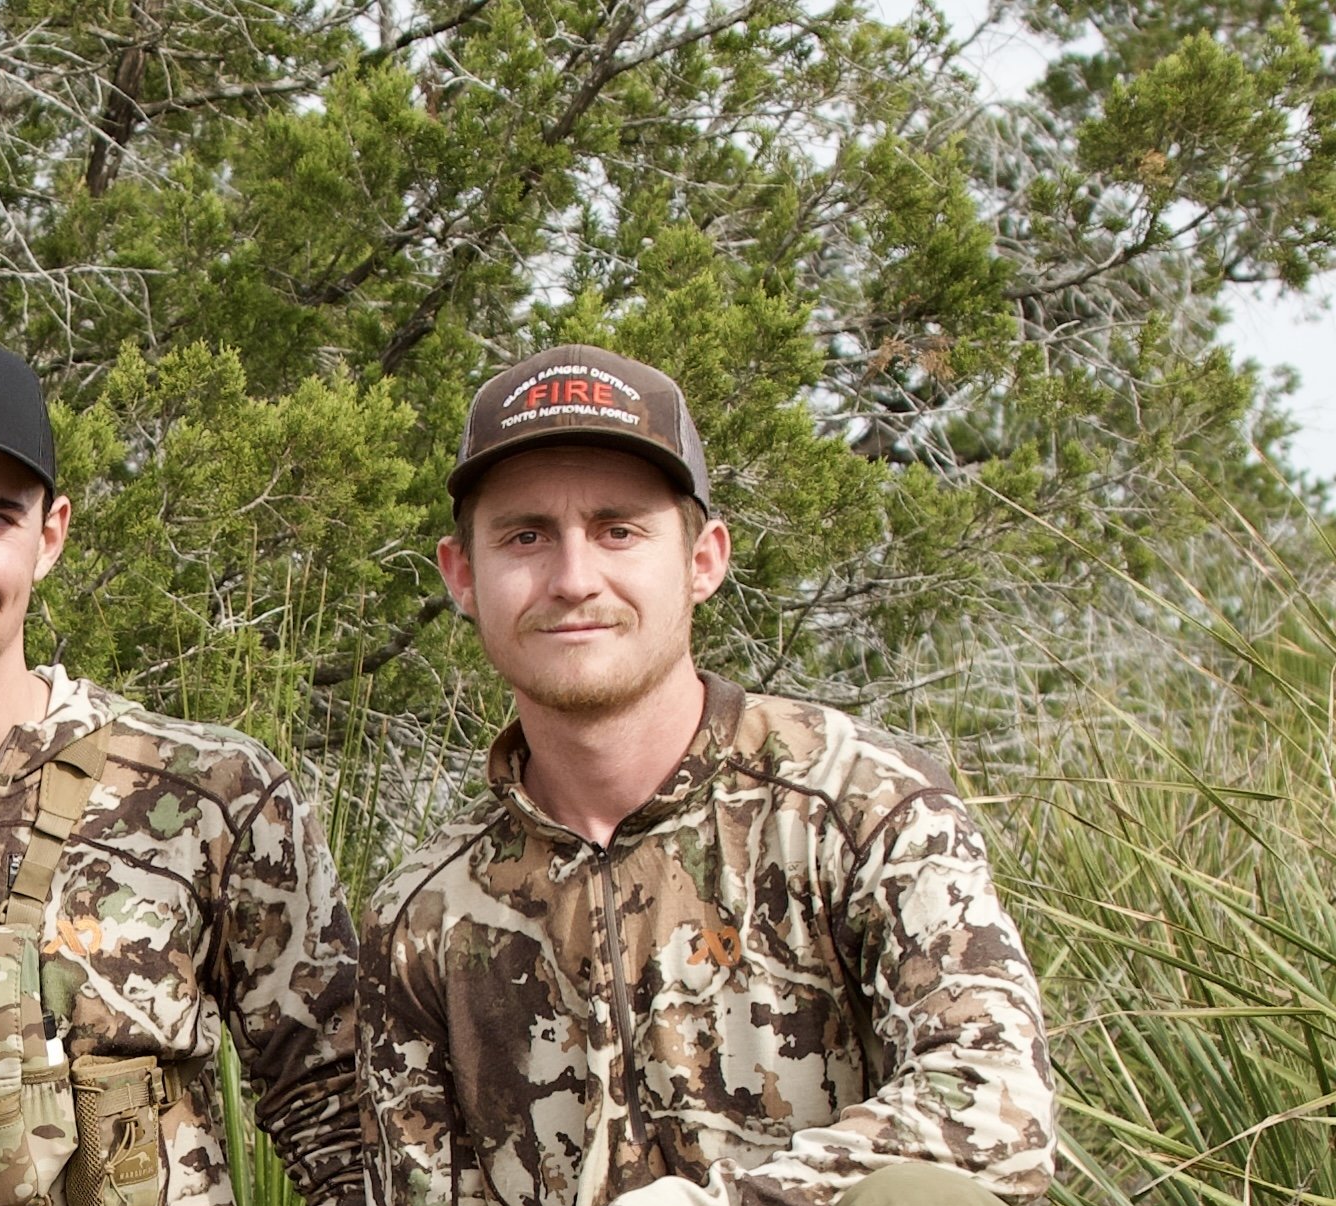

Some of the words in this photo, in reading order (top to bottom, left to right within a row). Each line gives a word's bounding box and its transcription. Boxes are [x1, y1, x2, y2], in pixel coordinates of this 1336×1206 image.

[502, 377, 537, 408] GLOBE
[538, 365, 588, 382] RANGER
[590, 367, 641, 401] DISTRICT
[526, 379, 614, 408] FIRE
[500, 410, 537, 430] TONTO
[539, 404, 599, 417] NATIONAL
[600, 407, 641, 426] FOREST
